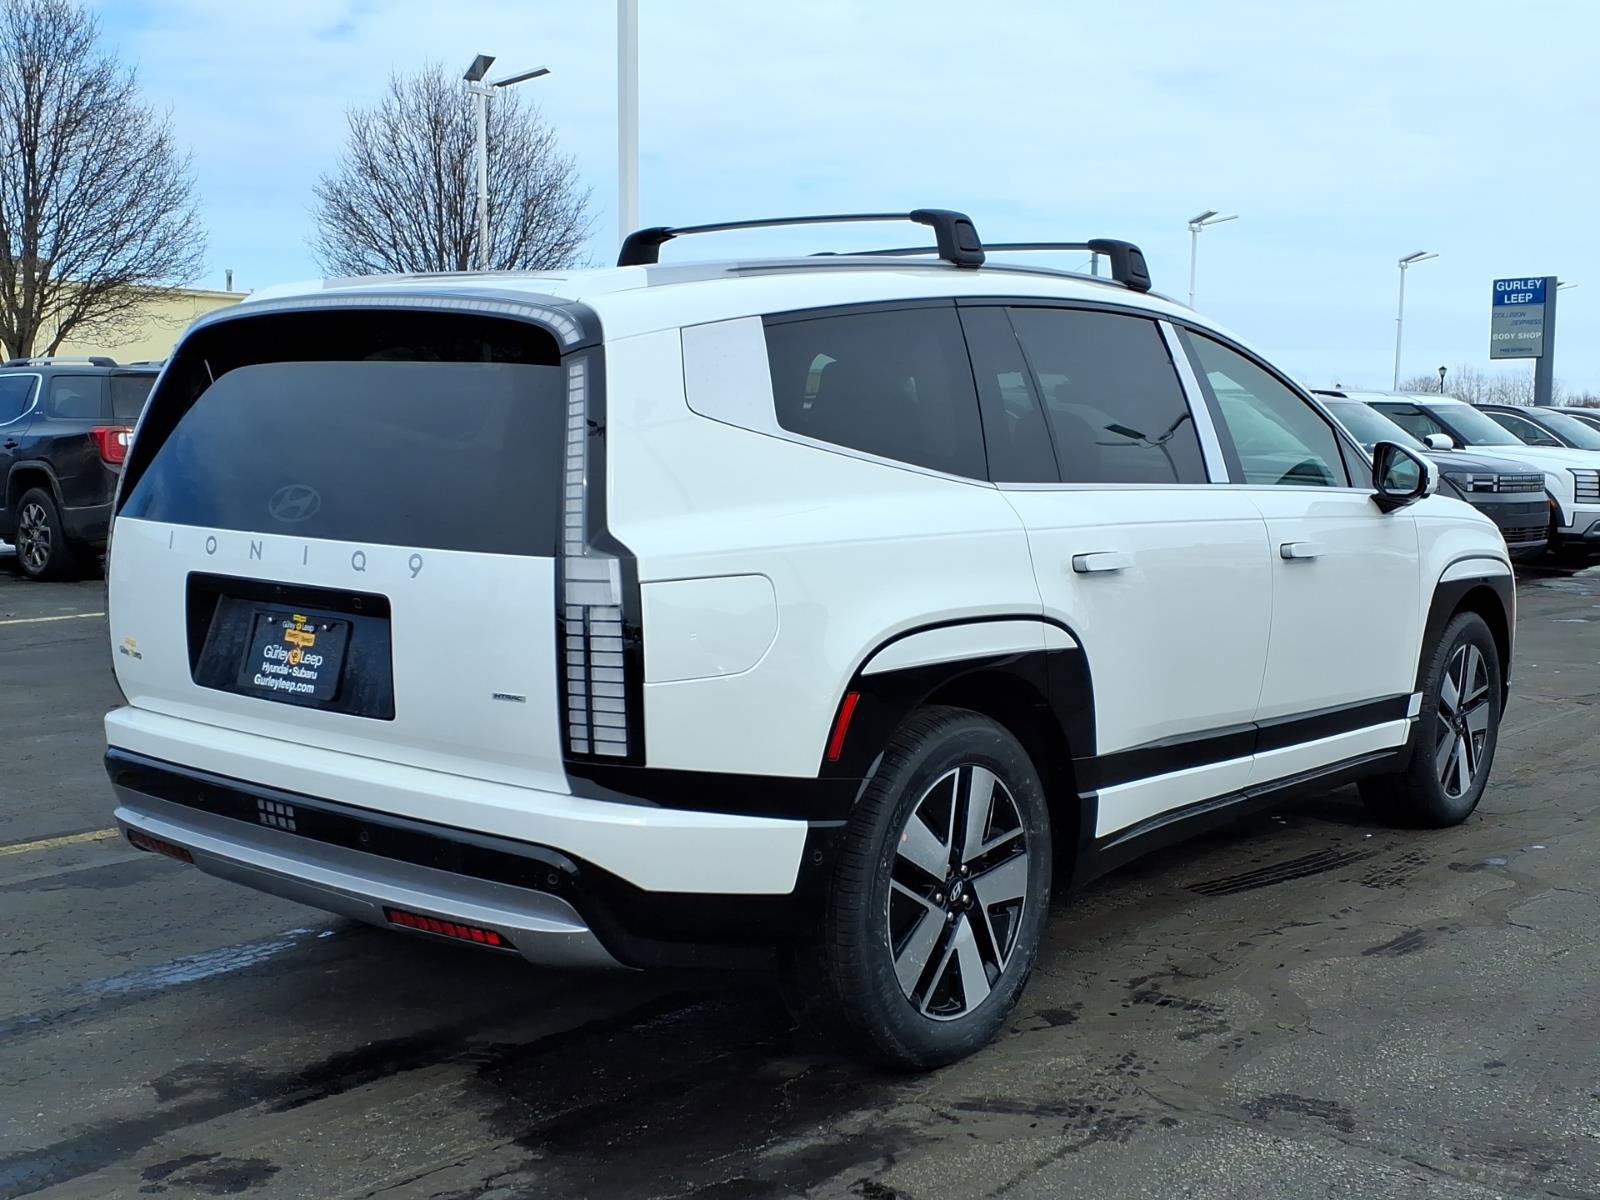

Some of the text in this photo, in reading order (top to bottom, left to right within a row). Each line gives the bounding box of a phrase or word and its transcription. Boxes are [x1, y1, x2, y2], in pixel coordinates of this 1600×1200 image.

[1496, 279, 1542, 291] GURLEY
[1504, 293, 1533, 304] LEEP
[1493, 332, 1542, 341] BODY SHOP
[169, 530, 424, 578] IONIQ 9
[264, 645, 322, 668] Gurley Leep
[254, 675, 315, 693] Gurleyleep.com
